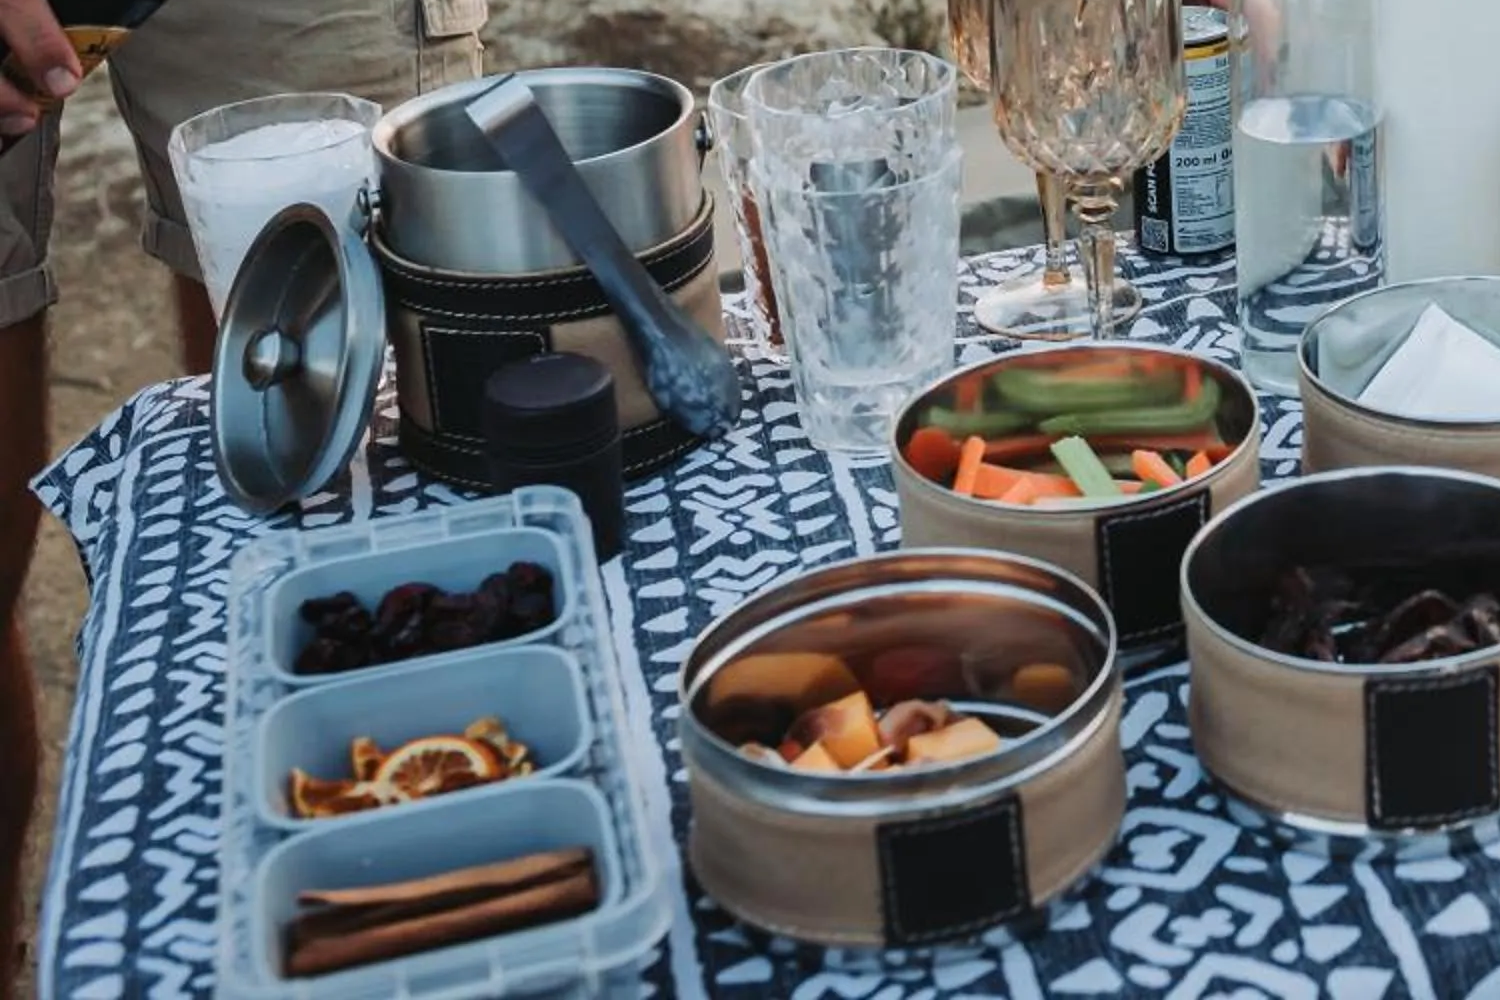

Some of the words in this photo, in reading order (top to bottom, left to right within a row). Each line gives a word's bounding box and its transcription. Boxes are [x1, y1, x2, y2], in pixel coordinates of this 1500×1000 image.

[1175, 156, 1201, 168] 200
[1203, 152, 1217, 165] ml
[1146, 179, 1158, 214] SCAN
